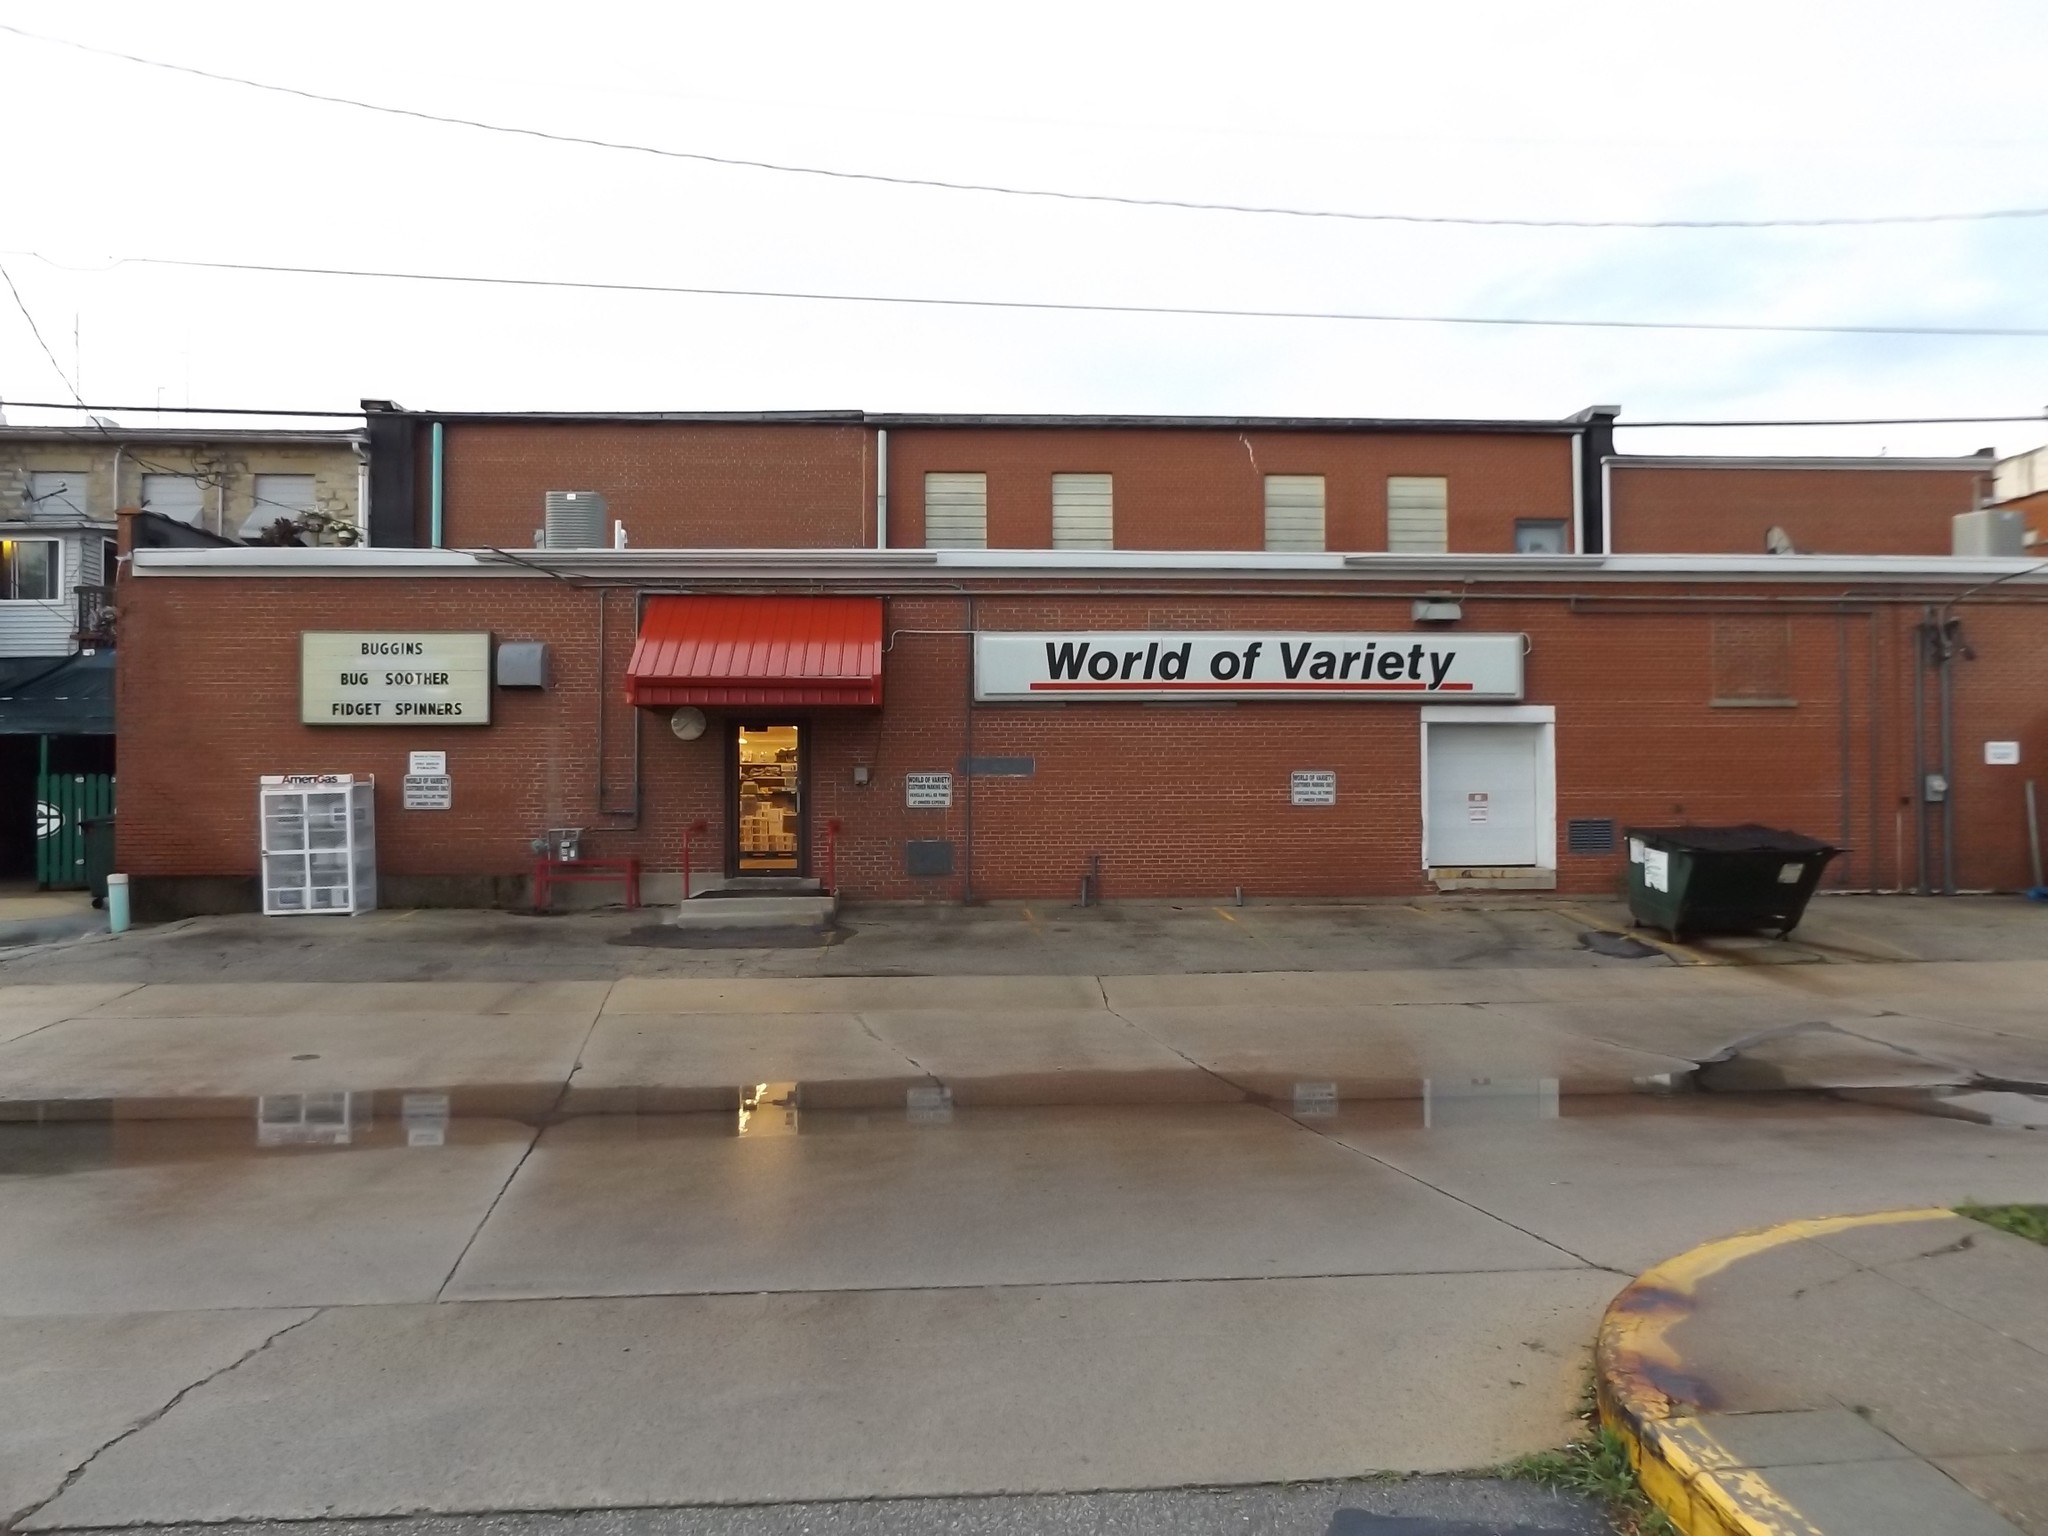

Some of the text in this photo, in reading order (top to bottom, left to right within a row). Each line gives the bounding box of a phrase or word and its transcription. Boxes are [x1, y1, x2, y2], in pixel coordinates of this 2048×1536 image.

[361, 643, 423, 655] BUGGINS
[1044, 641, 1456, 690] World of Variety
[340, 673, 449, 685] BUG SOOTHER
[332, 703, 462, 715] FIDGET SPINNERS
[281, 775, 338, 784] AmeriGas
